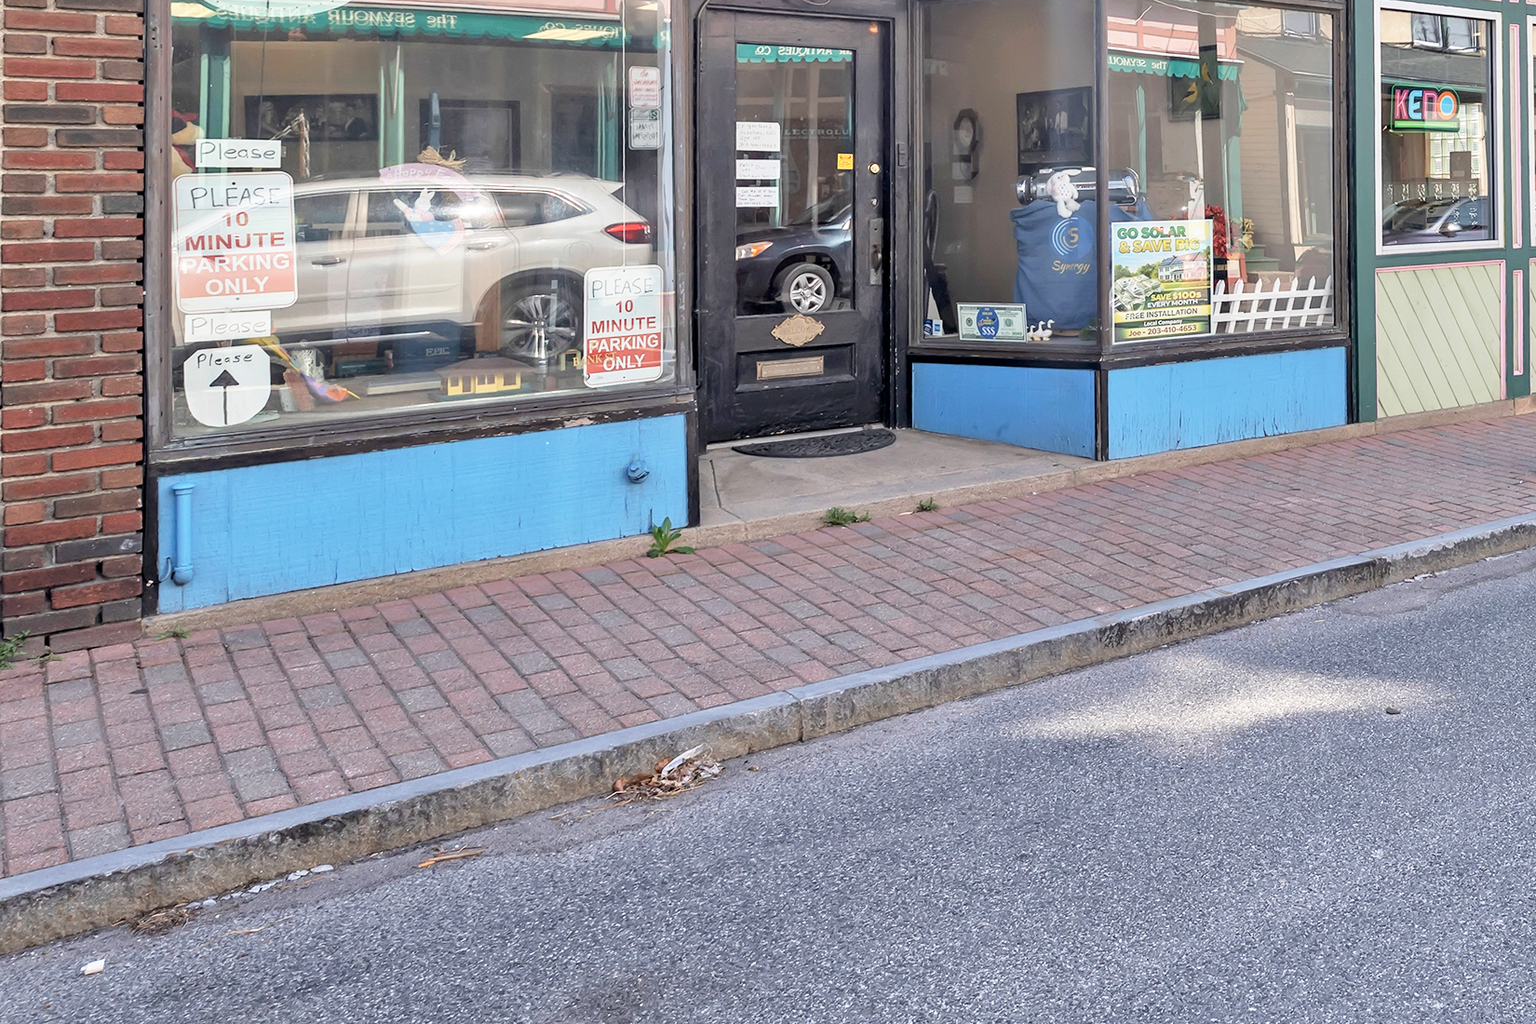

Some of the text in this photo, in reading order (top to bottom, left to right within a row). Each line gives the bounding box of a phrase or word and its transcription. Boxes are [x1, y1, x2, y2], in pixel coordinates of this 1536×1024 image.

[1394, 89, 1458, 121] KENO
[199, 141, 277, 163] Please
[190, 186, 281, 209] PLEASE
[222, 210, 250, 227] 10
[1117, 225, 1187, 239] GO SOLAR
[185, 231, 286, 252] MINUTE
[1118, 237, 1201, 254] & SAVE BIG
[180, 252, 290, 275] PARKING
[1051, 259, 1091, 275] Synergy
[205, 275, 270, 296] ONLY
[592, 278, 654, 298] PLEASE
[1147, 298, 1199, 309] EVERY MONTH
[1150, 290, 1202, 302] SAVE $100s
[615, 299, 634, 313] 10
[1125, 307, 1198, 321] FREE INSTALLATION
[191, 316, 268, 336] Please
[591, 316, 657, 334] MINUTE
[1128, 329, 1142, 338] Joe
[1147, 324, 1198, 335] 203-410-4653
[588, 334, 659, 355] PARKING
[196, 353, 253, 369] Please
[602, 353, 646, 371] ONLY
